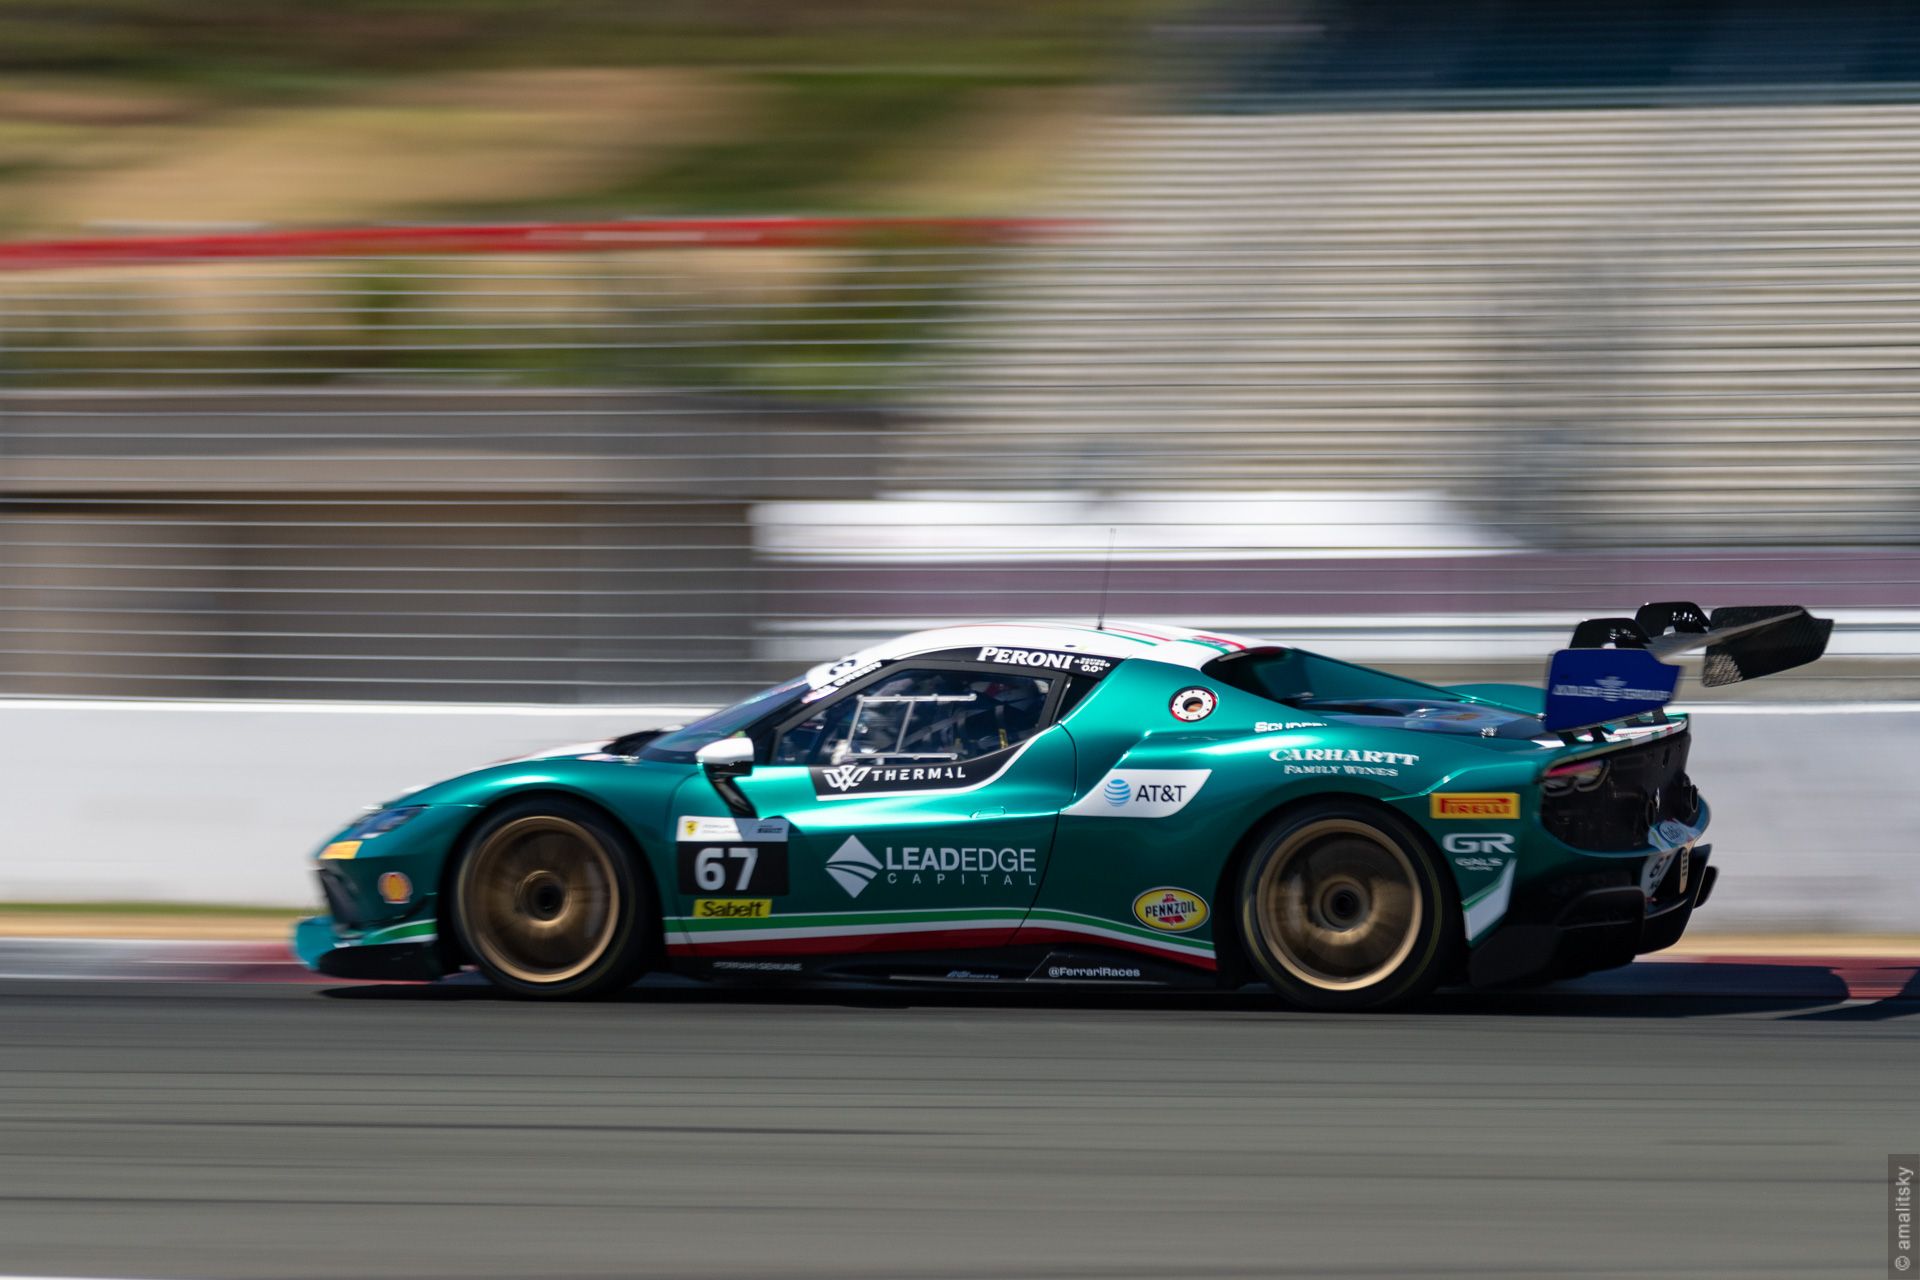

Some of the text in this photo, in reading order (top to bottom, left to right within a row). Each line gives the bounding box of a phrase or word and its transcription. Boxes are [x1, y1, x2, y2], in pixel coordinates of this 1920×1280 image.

[976, 646, 1074, 670] PERONI
[1269, 748, 1420, 766] CARHARTT
[871, 766, 966, 781] THERMAL
[1135, 785, 1187, 802] AT&T
[1439, 798, 1512, 814] PIRELLI
[1442, 832, 1515, 853] GR
[694, 847, 759, 892] 67
[887, 872, 1037, 886] CAPITAL
[701, 900, 764, 918] Sabelt
[1145, 900, 1198, 918] PENNZOIL
[1048, 966, 1141, 978] @FerrariRaces
